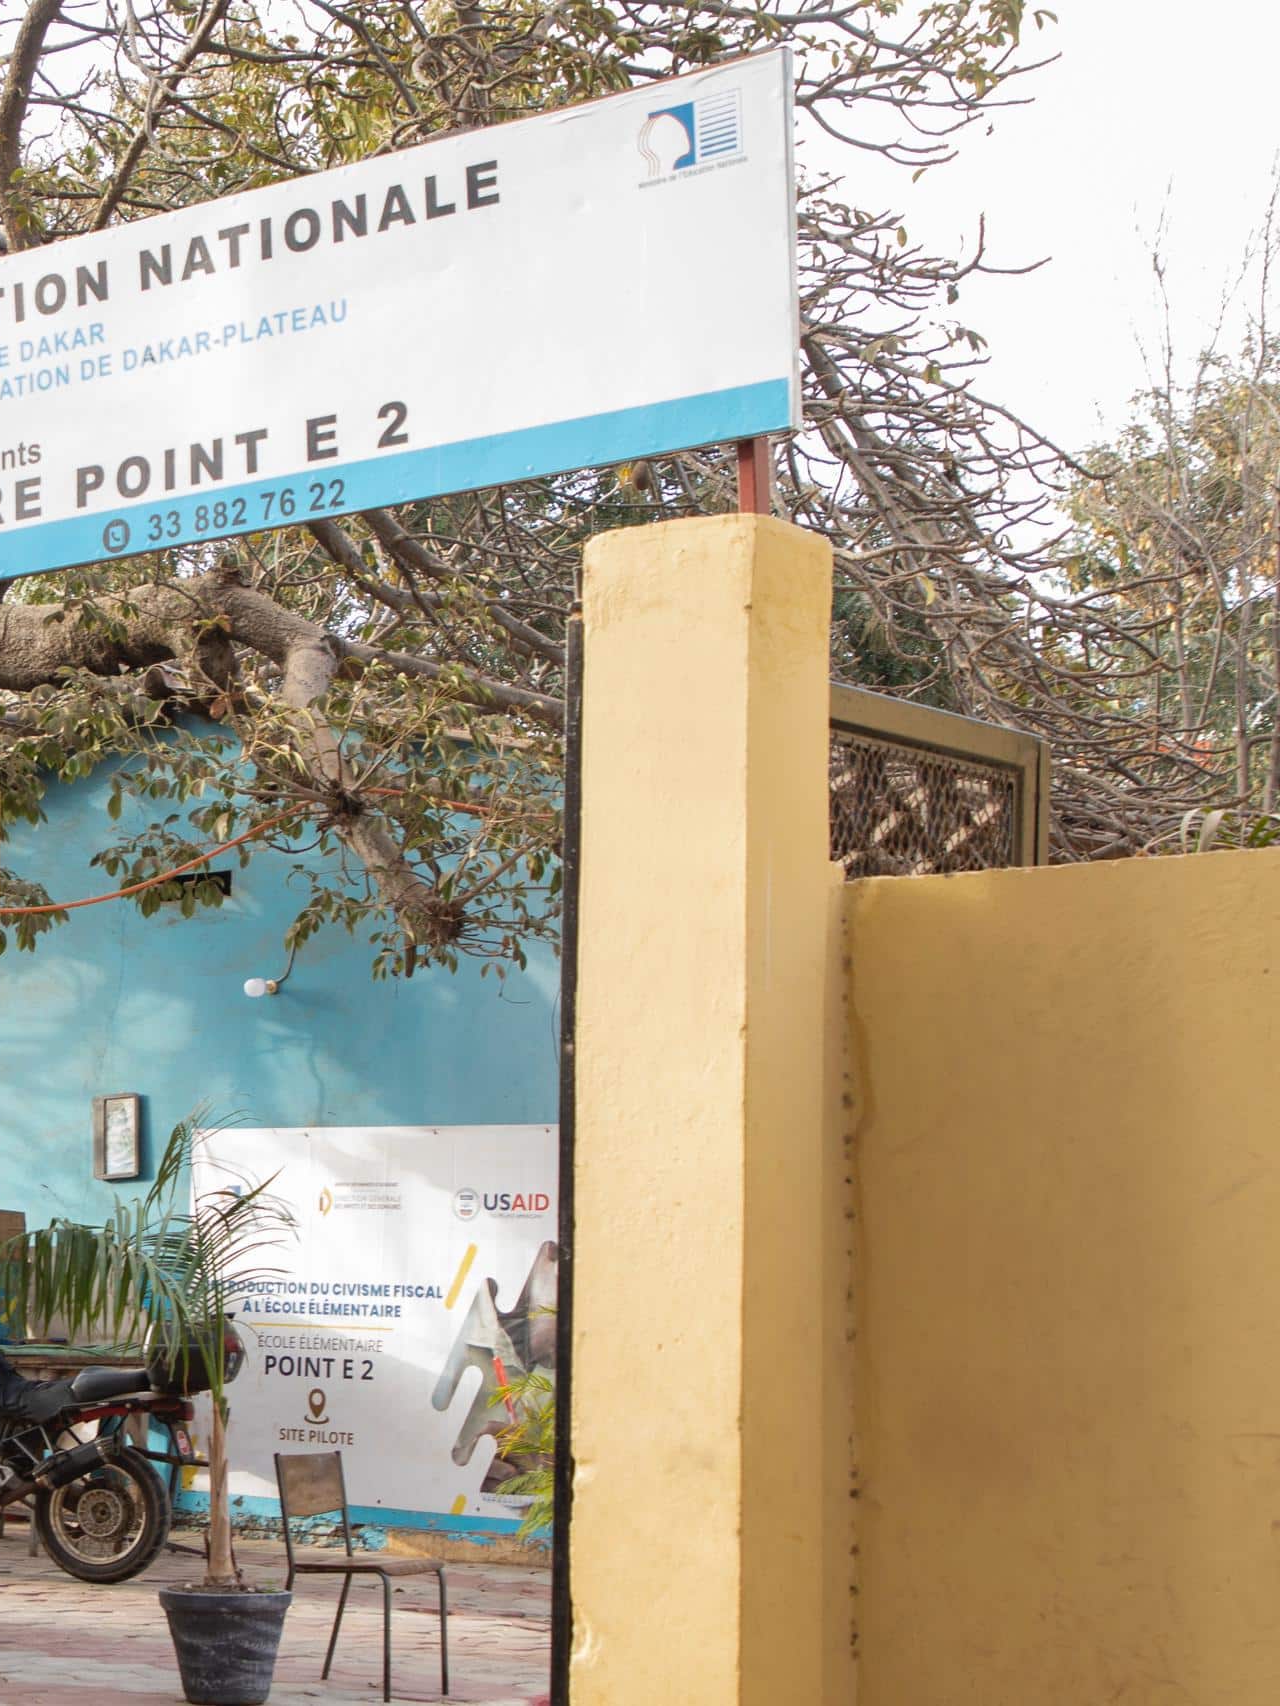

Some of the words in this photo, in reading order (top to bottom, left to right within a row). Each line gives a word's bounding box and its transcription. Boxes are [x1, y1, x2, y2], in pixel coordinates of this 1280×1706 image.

[139, 159, 500, 292] NATIONALE
[20, 323, 105, 362] DAKAR
[80, 354, 112, 381] DE
[123, 299, 348, 371] DAKAR-PLATEAU
[76, 428, 268, 508] POINT
[307, 414, 338, 462] E
[377, 401, 409, 449] 2
[148, 511, 181, 541] 33
[195, 498, 247, 532] 882
[260, 488, 295, 520] 76
[309, 479, 345, 511] 22
[484, 1193, 549, 1211] USAID
[311, 1283, 329, 1295] DU
[332, 1283, 390, 1297] CIVISME
[393, 1285, 443, 1299] FISCAL
[309, 1298, 401, 1318] ÉLÉMENTAIRE
[258, 1332, 296, 1349] ÉCOLE
[300, 1332, 384, 1352] ÉLÉMENTAIRE
[264, 1355, 334, 1378] POINT
[343, 1359, 354, 1379] E
[361, 1359, 374, 1380] 2
[279, 1428, 305, 1442] SITE
[308, 1430, 354, 1445] PILOTE
